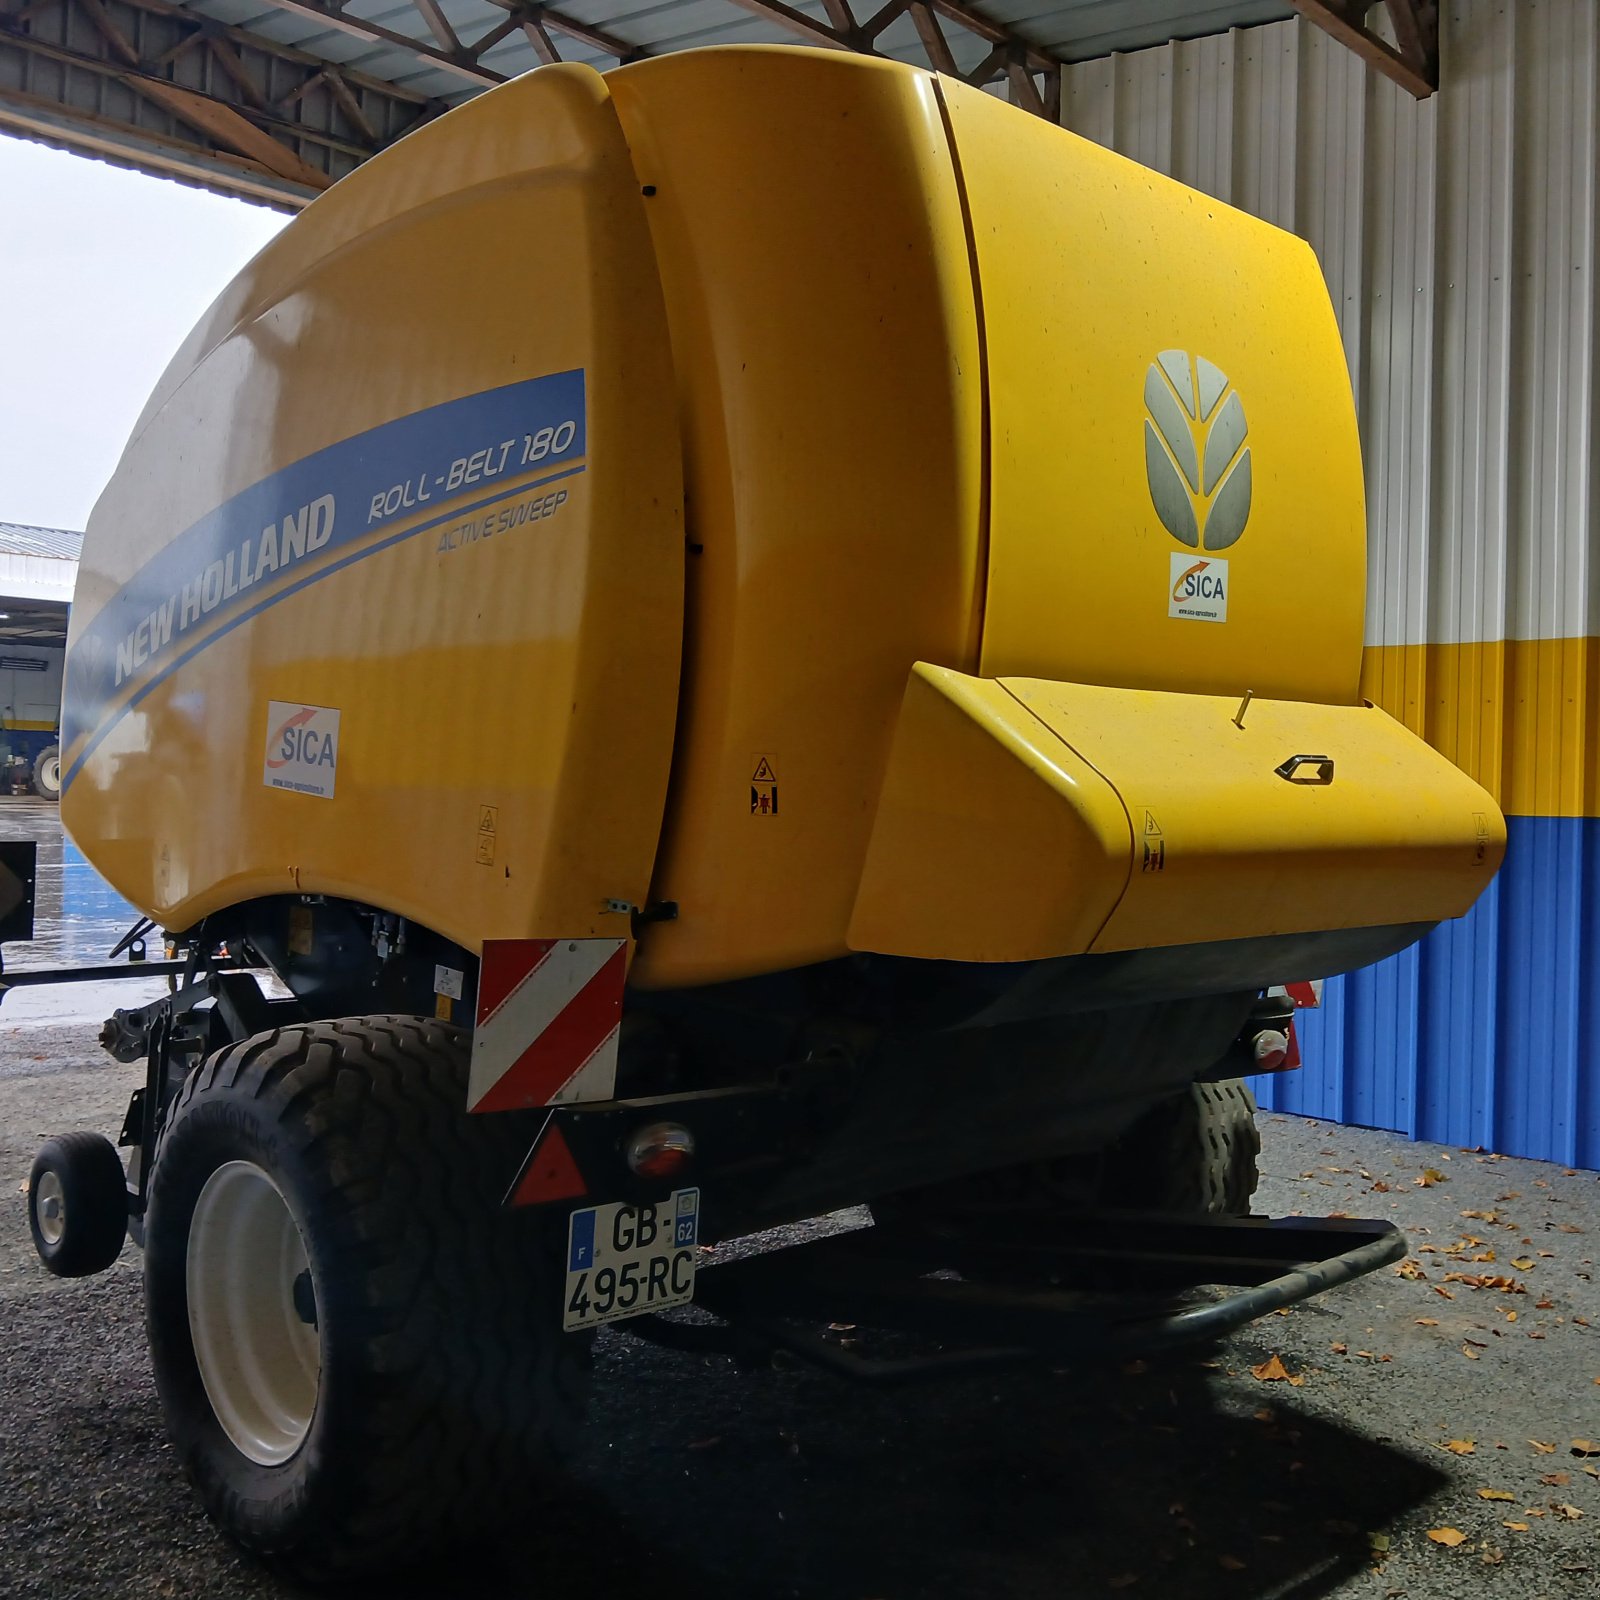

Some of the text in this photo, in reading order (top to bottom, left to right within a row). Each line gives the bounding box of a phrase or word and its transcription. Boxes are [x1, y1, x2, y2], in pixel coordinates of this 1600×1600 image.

[521, 420, 576, 465] 180
[436, 490, 568, 554] ACTIVE SWEEP
[115, 494, 336, 687] NEW HOLLAND
[1185, 573, 1225, 600] SICA
[281, 727, 335, 768] SICA
[677, 1222, 693, 1241] 62
[578, 1247, 586, 1260] F
[568, 1251, 692, 1318] 495-RC
